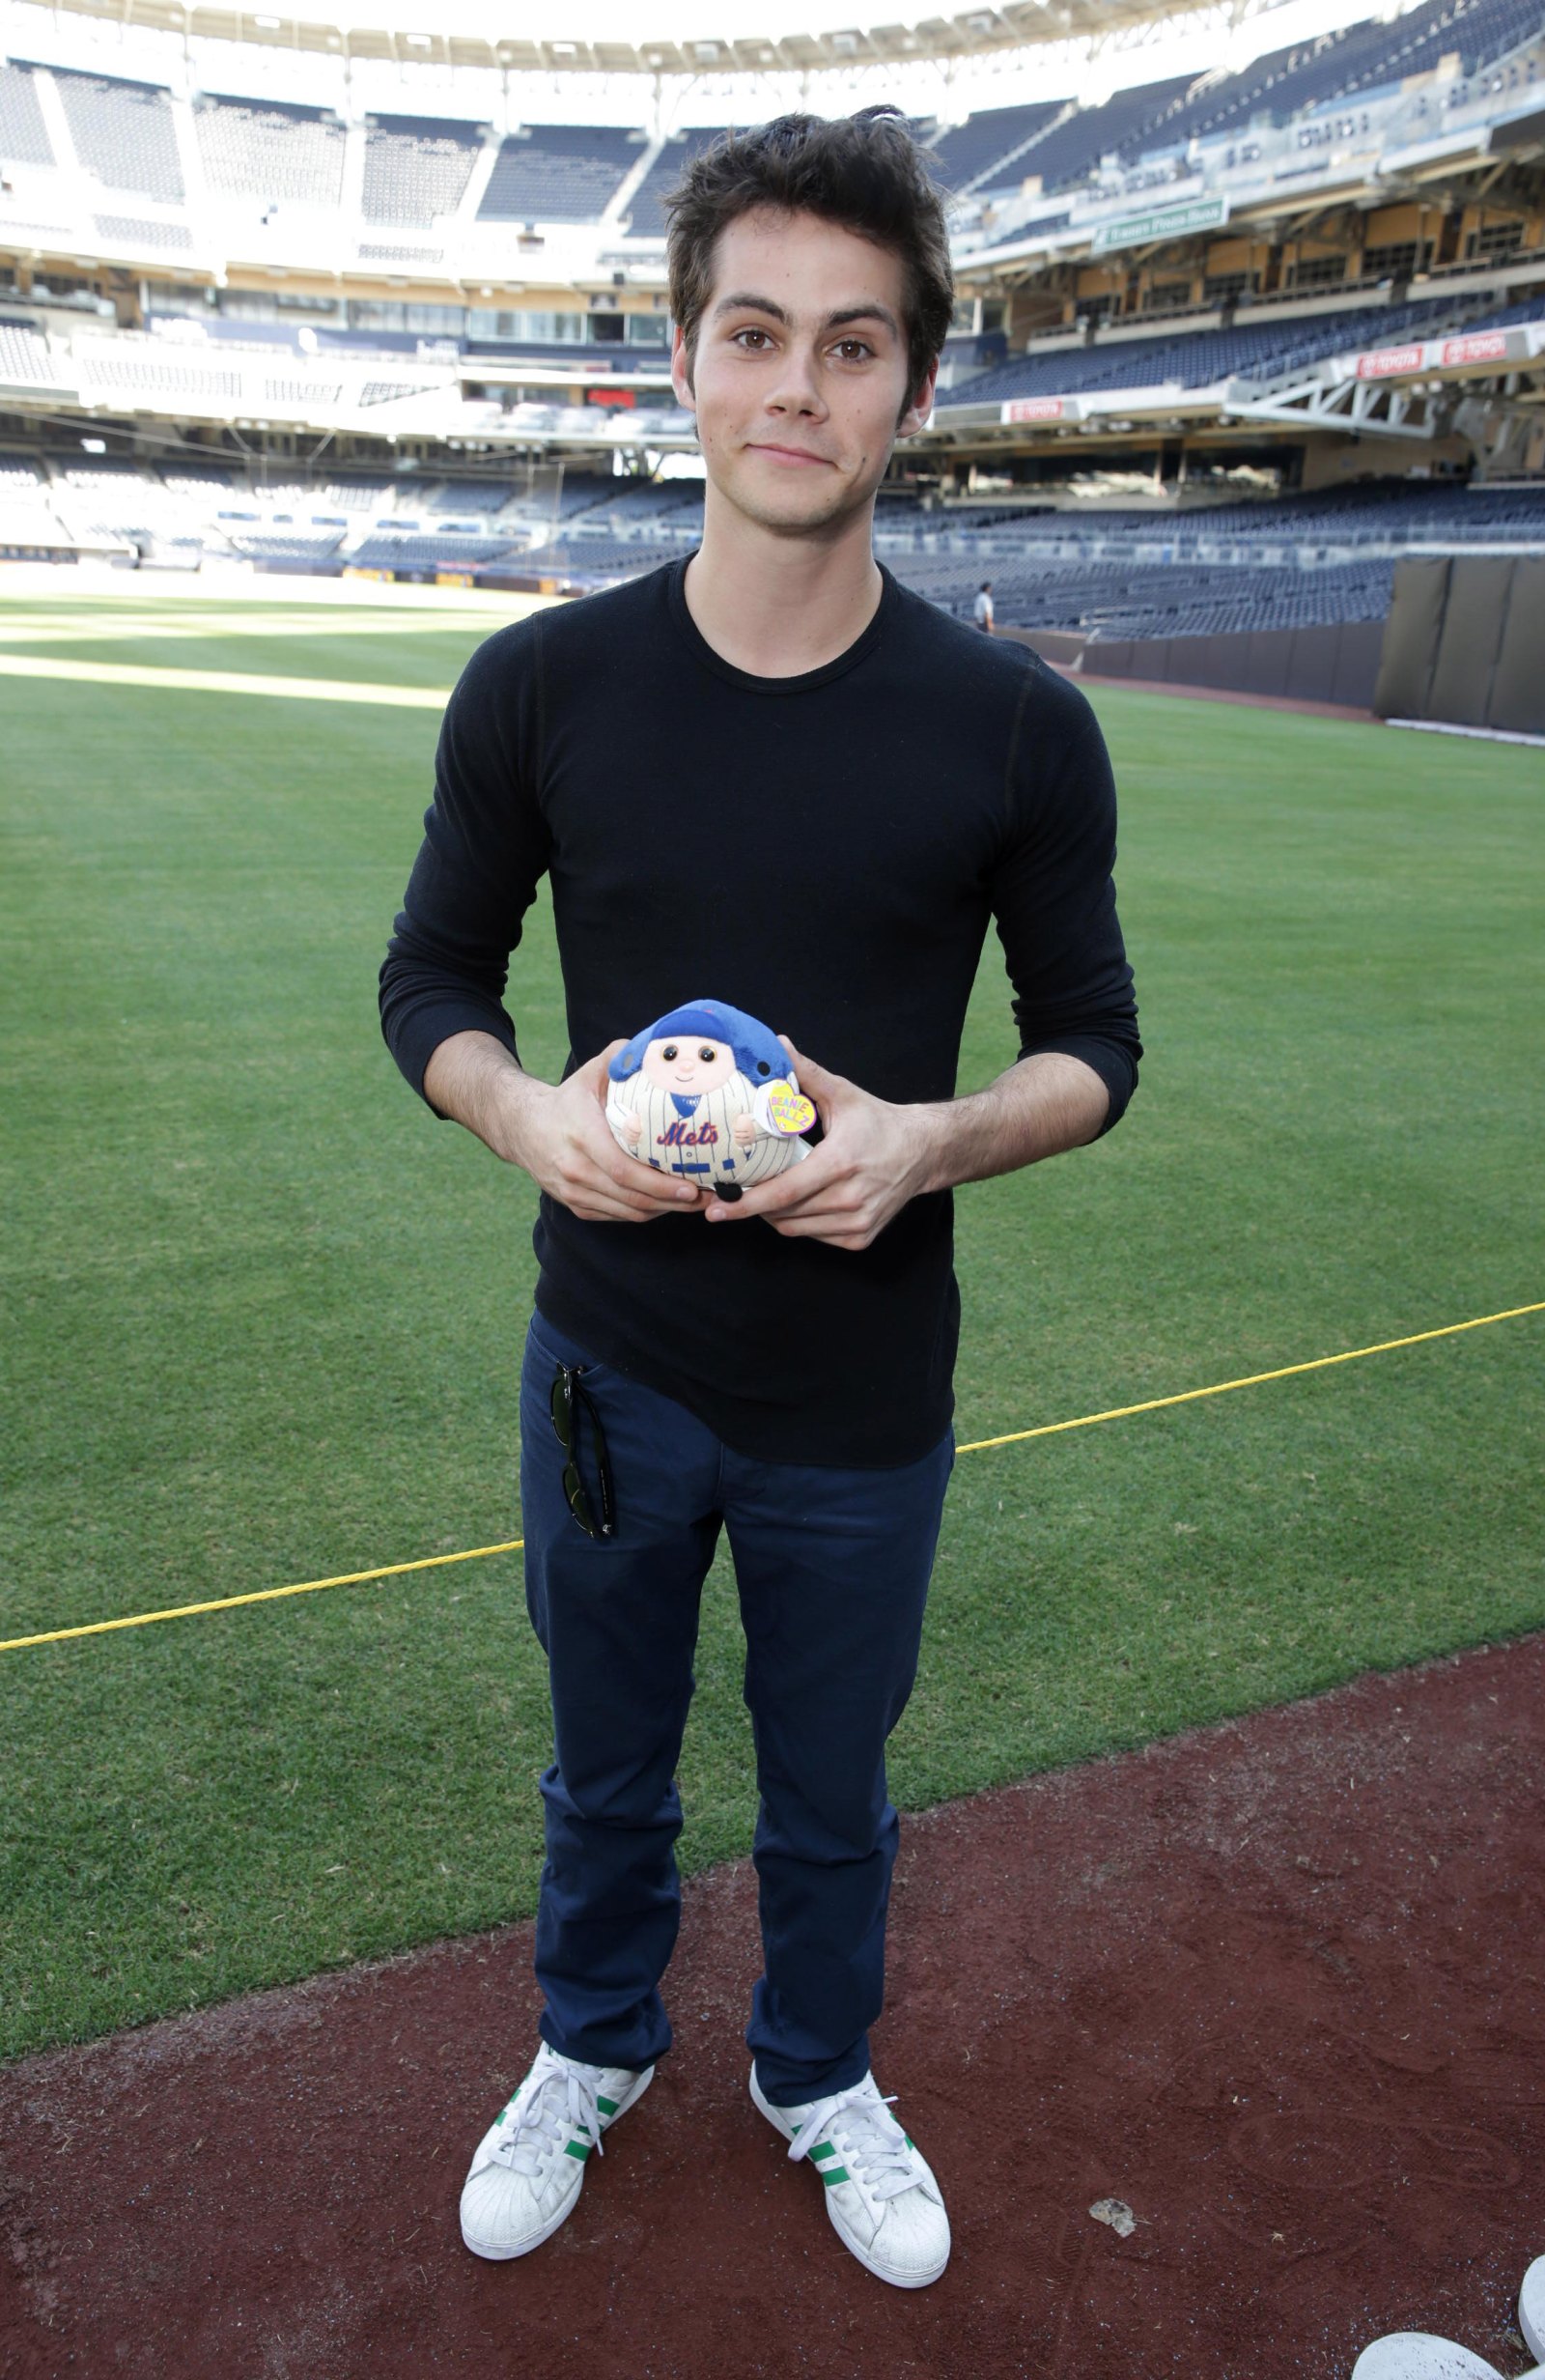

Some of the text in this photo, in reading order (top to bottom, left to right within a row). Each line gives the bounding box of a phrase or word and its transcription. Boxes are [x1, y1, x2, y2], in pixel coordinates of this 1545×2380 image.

[772, 1096, 809, 1113] BEANIE
[774, 1107, 810, 1128] BALLZ
[657, 1121, 719, 1147] Mets
